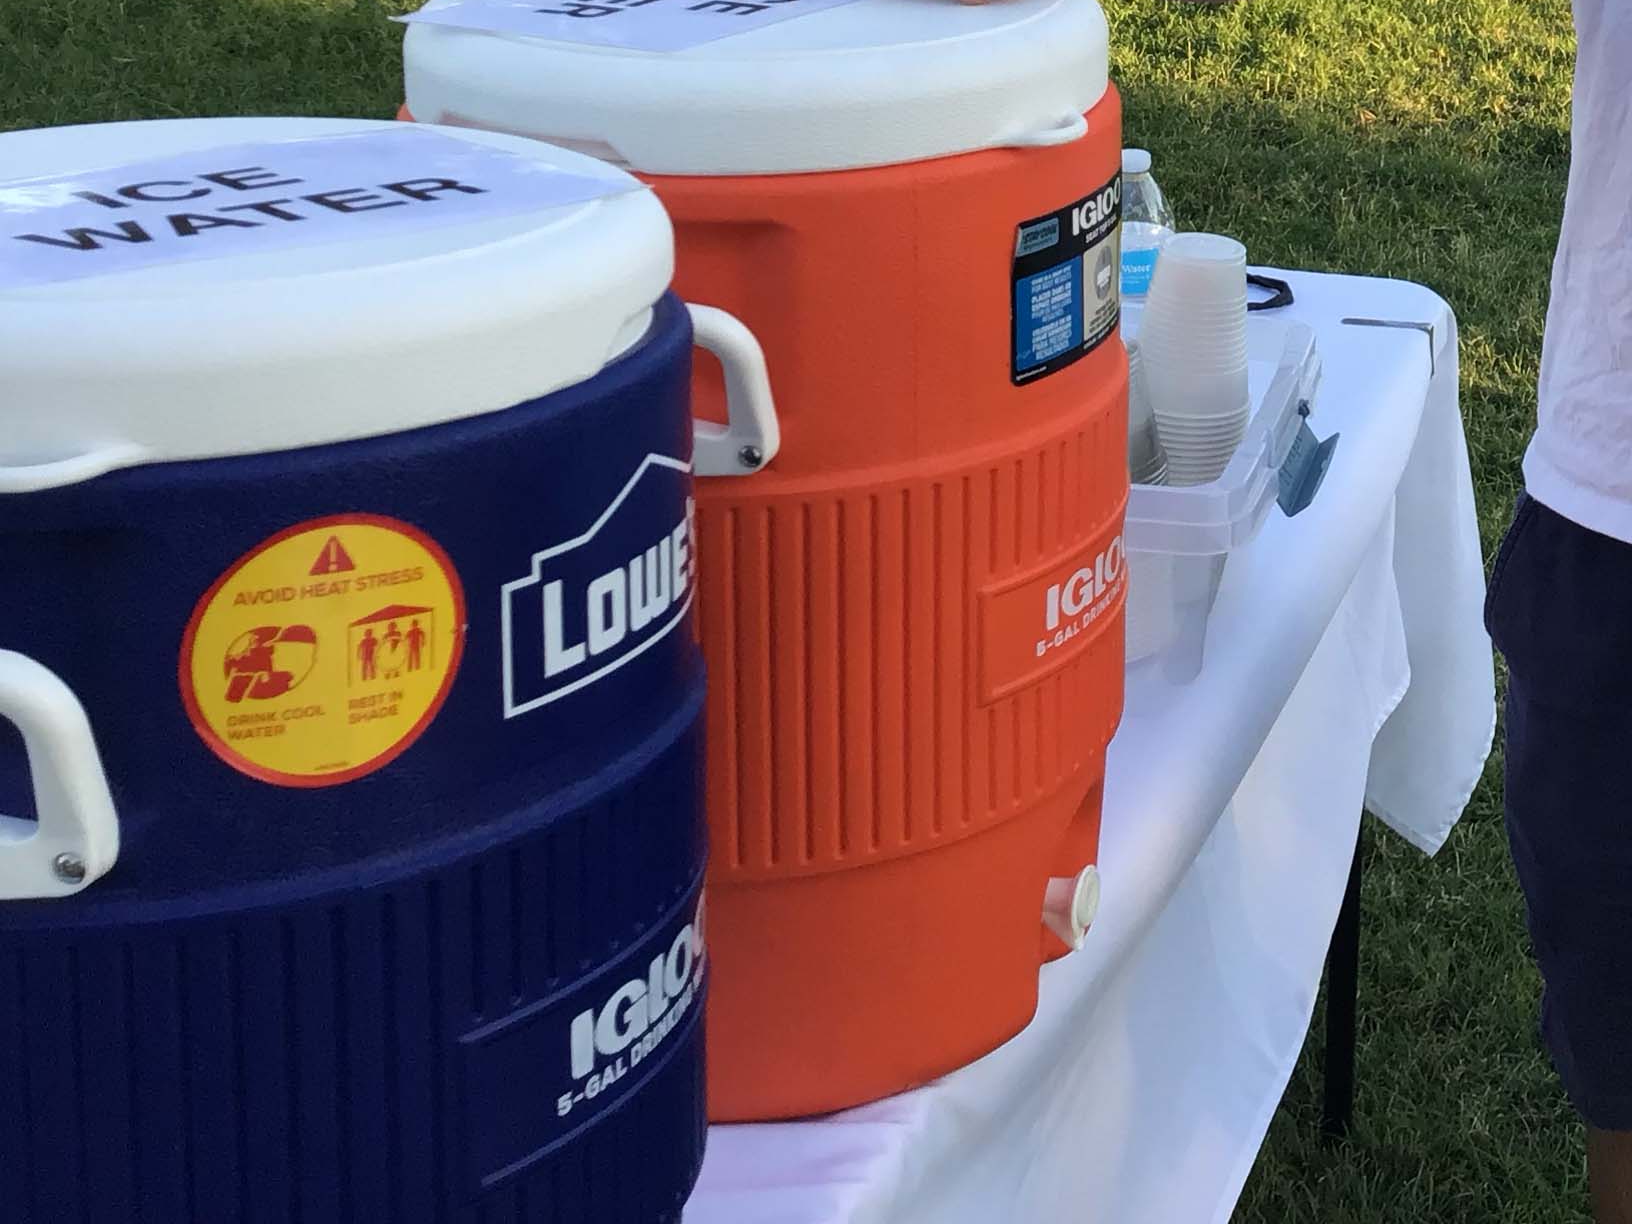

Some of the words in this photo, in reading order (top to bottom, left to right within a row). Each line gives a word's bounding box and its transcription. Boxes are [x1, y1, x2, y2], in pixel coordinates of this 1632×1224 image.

[72, 167, 304, 209] ICE
[1072, 177, 1120, 236] IGLOO
[13, 178, 488, 251] WATER
[233, 587, 296, 607] AVOID
[301, 580, 350, 600] HEAT
[356, 566, 425, 592] STRESS
[1046, 524, 1125, 631] IGLO
[227, 711, 277, 727] DRINK
[282, 705, 325, 721] COOL
[227, 725, 286, 741] WATER
[349, 704, 399, 725] SHADE
[557, 1056, 627, 1116] 5-GAL
